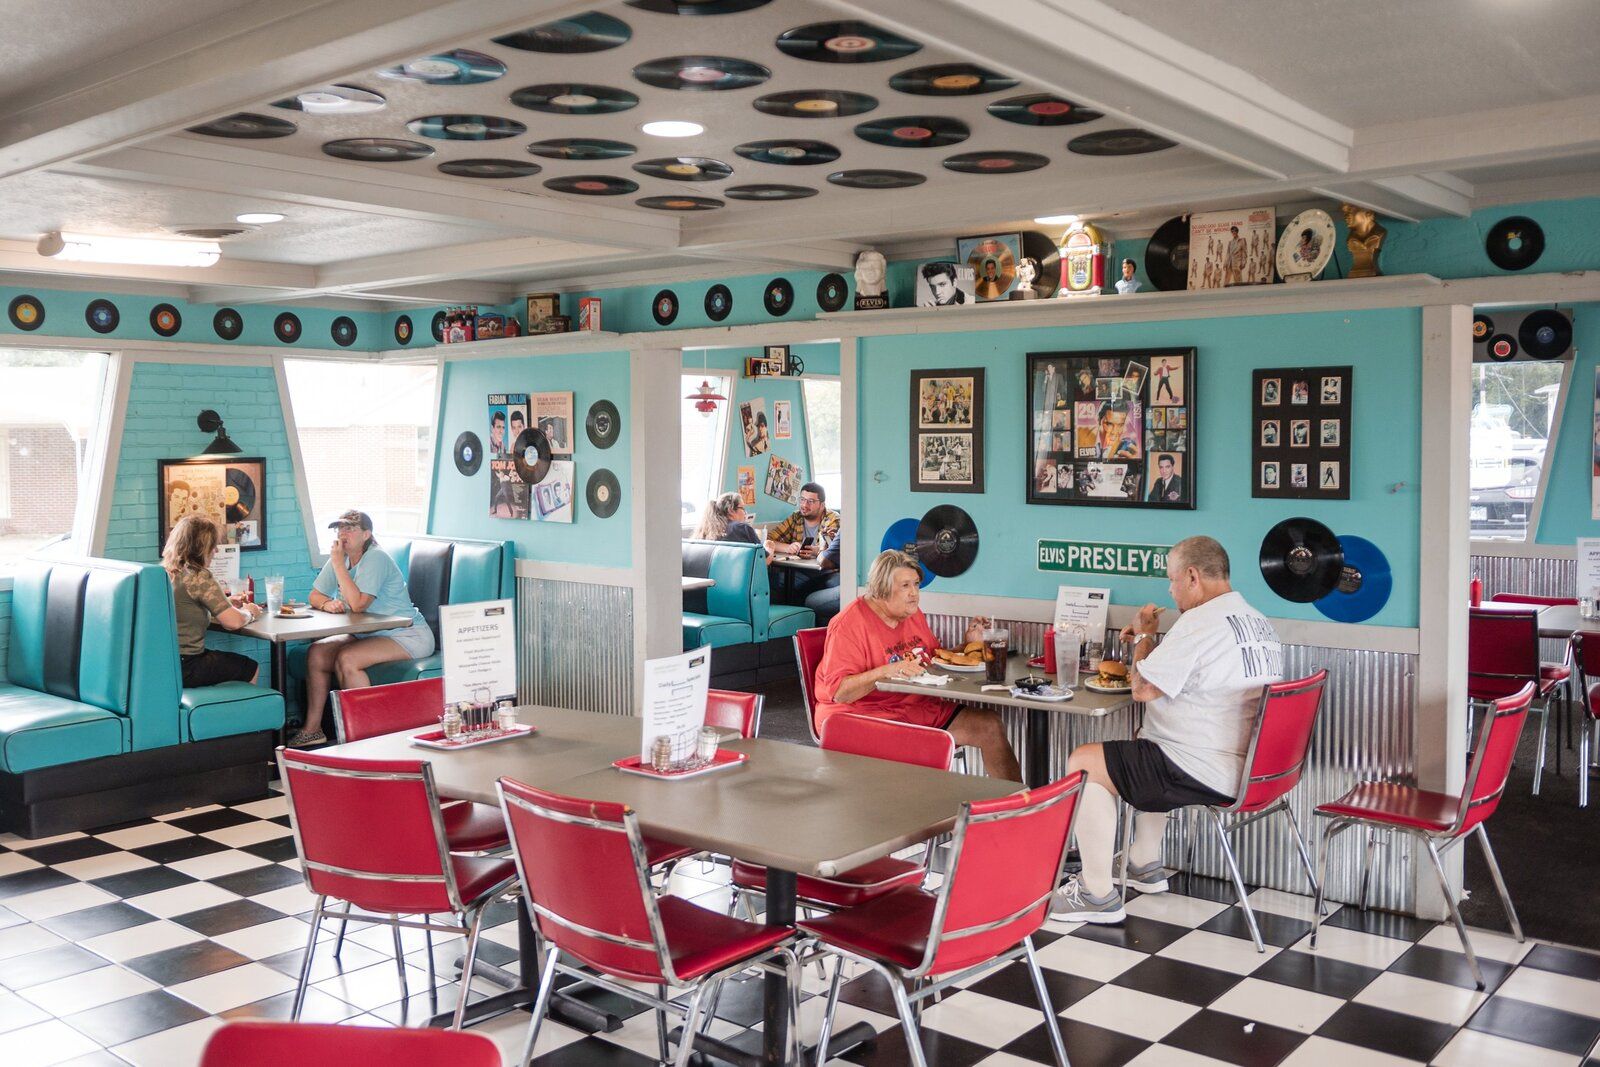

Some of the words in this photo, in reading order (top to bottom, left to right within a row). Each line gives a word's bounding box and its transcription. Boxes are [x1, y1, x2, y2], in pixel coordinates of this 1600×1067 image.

[489, 395, 507, 405] FABIAN
[1078, 402, 1096, 419] 29
[1134, 401, 1142, 419] USA
[1079, 447, 1096, 457] ELVIS
[506, 460, 516, 470] JO
[1040, 547, 1065, 564] ELVIS
[1067, 546, 1152, 572] PRESLEY
[457, 623, 499, 634] APPETIZERS
[1241, 645, 1263, 678] MY
[1262, 645, 1281, 677] RUL
